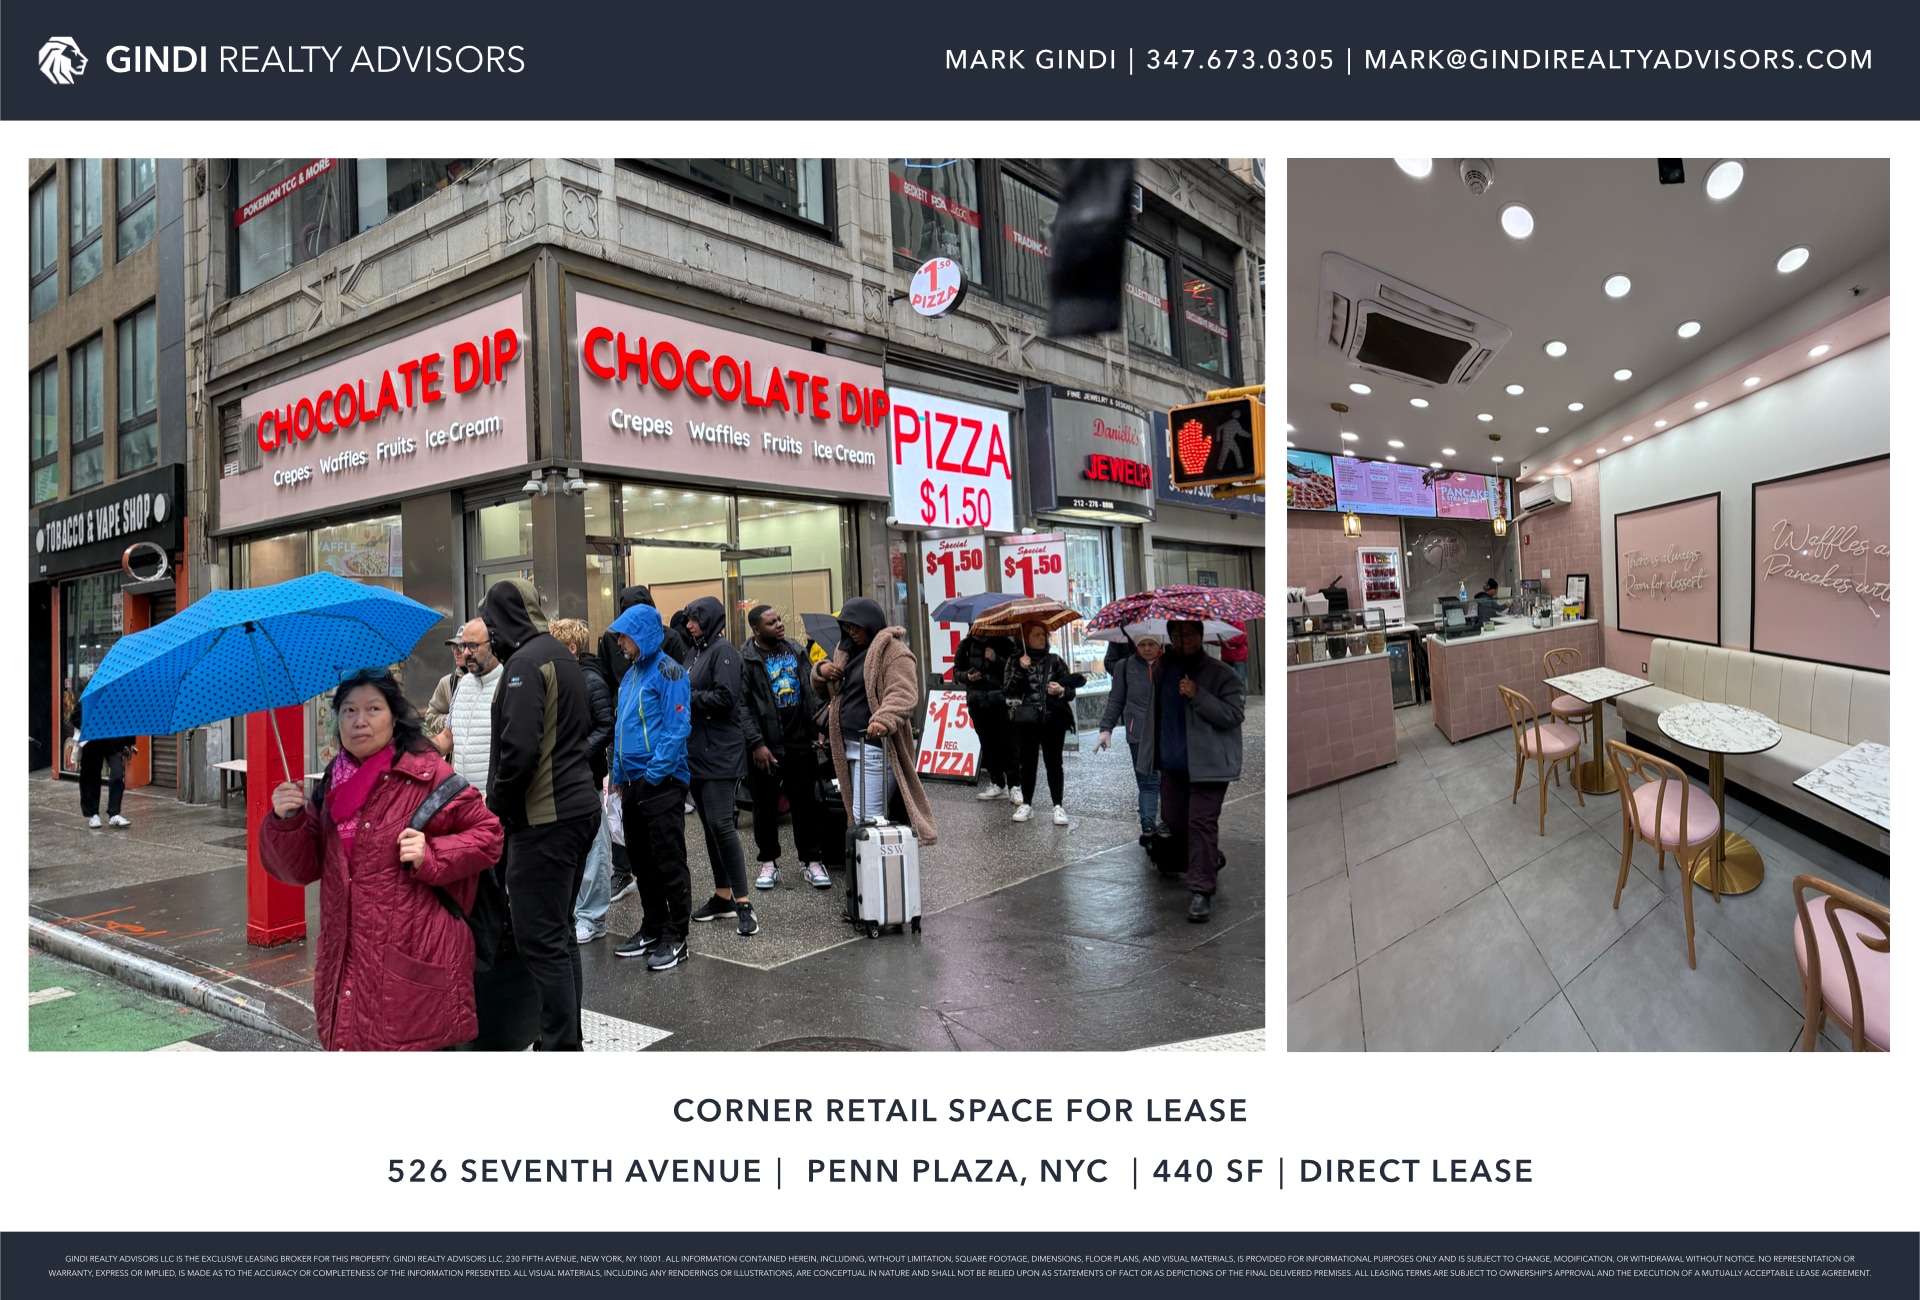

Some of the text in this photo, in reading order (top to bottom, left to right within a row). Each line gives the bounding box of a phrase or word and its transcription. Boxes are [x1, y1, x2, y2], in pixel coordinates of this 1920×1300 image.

[243, 187, 281, 219] POKEMON
[298, 172, 305, 184] &
[305, 158, 331, 181] MORE
[931, 194, 947, 211] PSA
[1013, 230, 1044, 255] TRADING
[911, 285, 958, 309] PIZZA
[257, 328, 521, 452] CHOCOLATE DIP
[583, 325, 891, 428] CHOCOLATE DIP
[1066, 390, 1082, 399] FINE
[1083, 392, 1109, 405] JEWELRY
[610, 407, 876, 466] Crepes Waffles Fruits Ice Cream
[893, 403, 1012, 480] PIZZA
[1092, 417, 1140, 447] Danielle's
[273, 414, 501, 488] Crepes Waffles Fruits Ice Cream
[920, 478, 992, 528] $1.50
[45, 492, 150, 553] TOBACCO & VAPE SHOP
[939, 539, 968, 551] Special
[1017, 546, 1047, 557] Special
[1772, 518, 1870, 560] Waffles
[926, 549, 983, 599] $1.50
[1623, 543, 1701, 574] There is always
[1004, 553, 1063, 599] $1.50
[1621, 568, 1709, 598] Room for dessert
[1763, 553, 1890, 602] Pancakes wit
[941, 691, 967, 703] Spec
[943, 741, 959, 751] REG.
[917, 750, 975, 777] PIZZA
[880, 845, 905, 856] SSW
